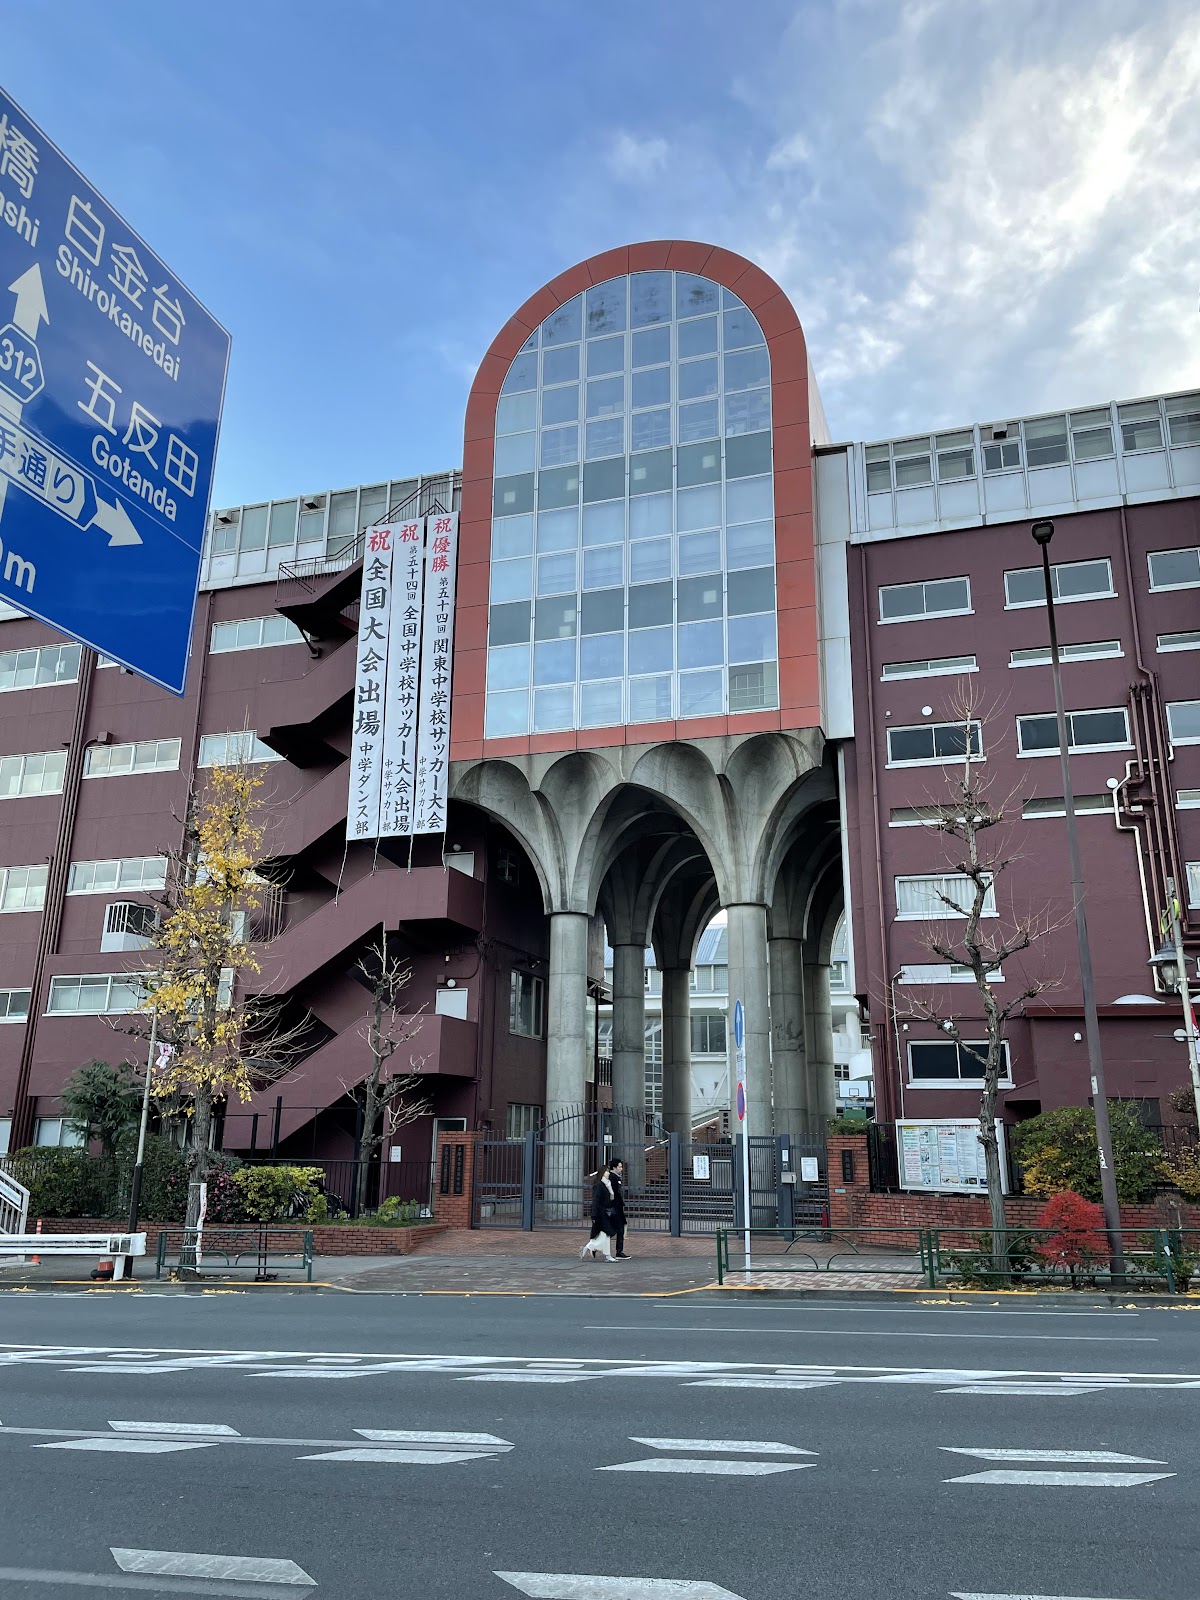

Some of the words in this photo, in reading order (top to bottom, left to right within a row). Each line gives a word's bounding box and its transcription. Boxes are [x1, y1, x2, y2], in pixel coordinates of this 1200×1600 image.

[65, 194, 186, 346] 白金台
[55, 244, 180, 382] Shirokanedai
[0, 338, 37, 392] 312
[77, 360, 199, 497] 五反田
[91, 434, 177, 522] Gotanda
[366, 529, 392, 553] 祝
[398, 523, 420, 543] 祝
[406, 545, 419, 601] 第五十四回
[431, 517, 452, 573] 祝優勝
[436, 576, 450, 634] 第五十四回
[354, 556, 389, 737] 全国大会出場
[392, 605, 420, 833] 全国中学校サッカー大会出場
[426, 637, 450, 829] 関東中学校サッカー大会
[355, 741, 374, 835] 中学ダンス部
[382, 758, 394, 832] 中学サッカー部
[416, 756, 427, 830] 中学サッカー部
